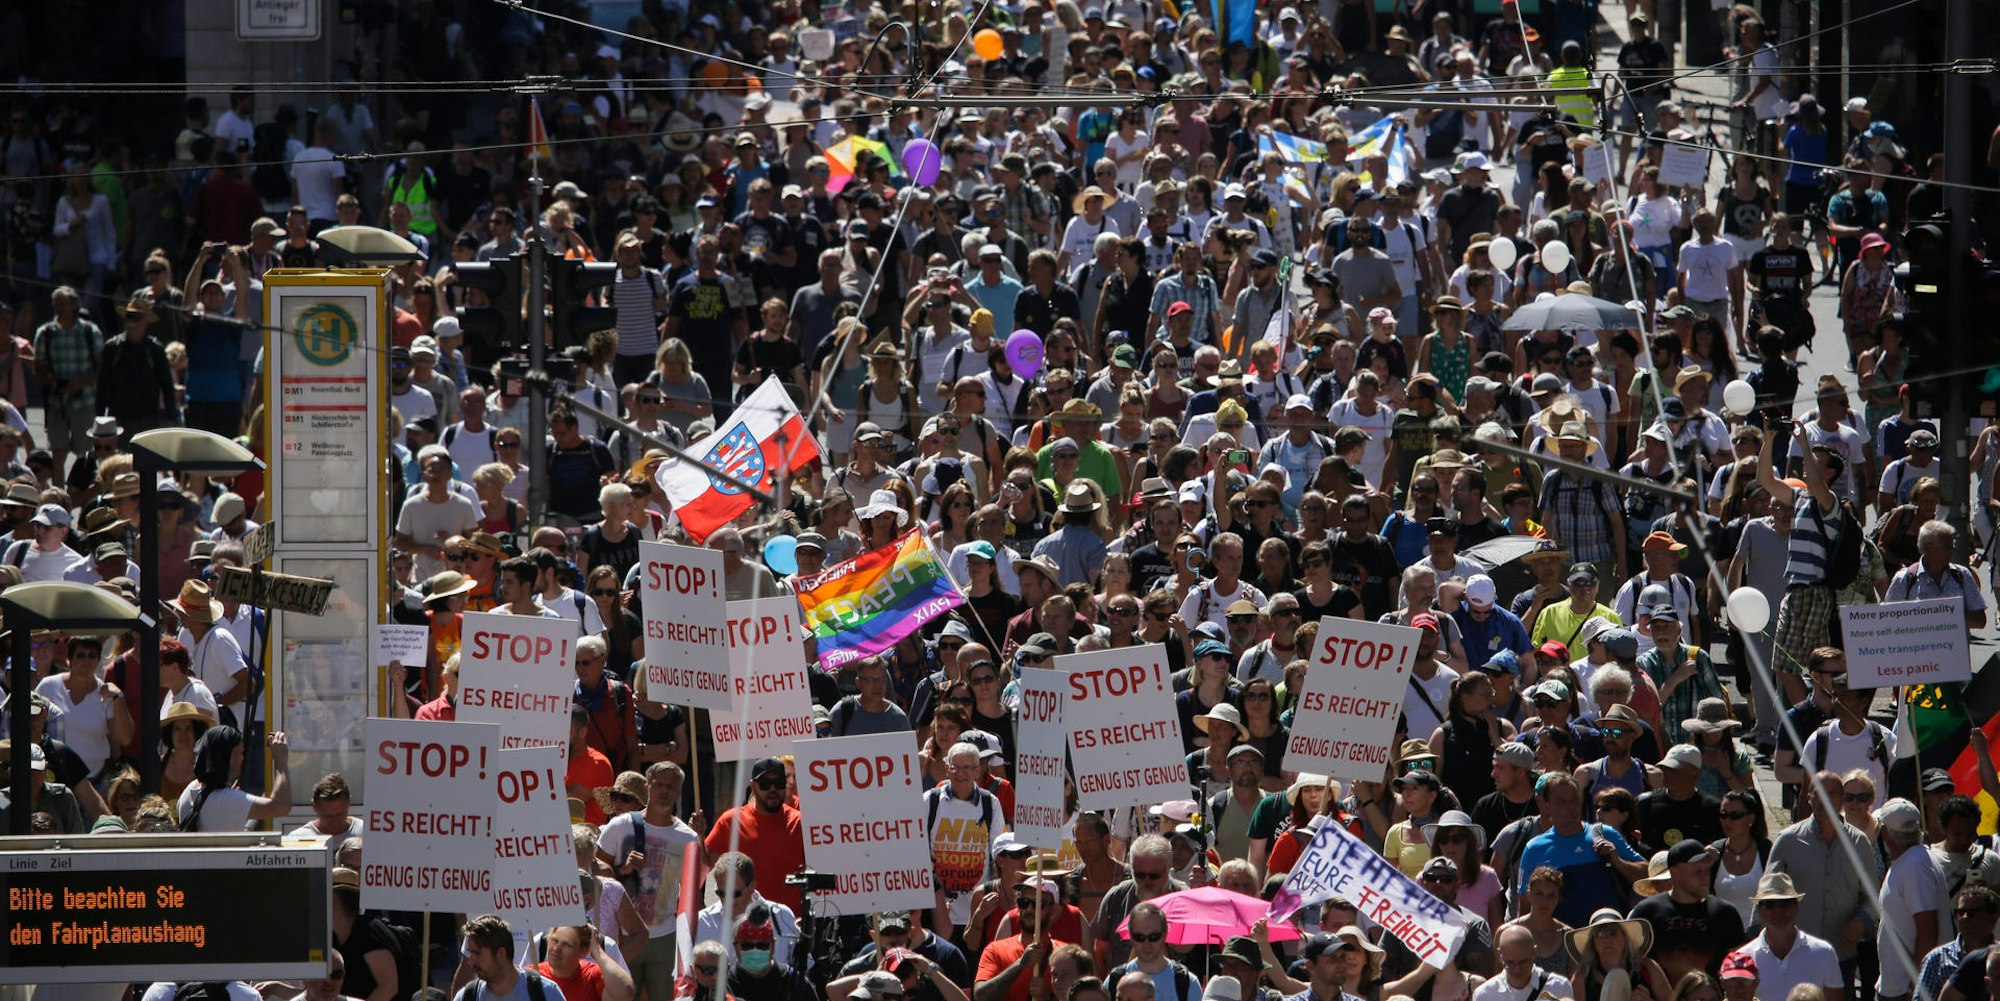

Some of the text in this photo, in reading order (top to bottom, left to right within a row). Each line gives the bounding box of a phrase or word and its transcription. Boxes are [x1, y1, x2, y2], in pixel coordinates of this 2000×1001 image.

[256, 0, 300, 12] Anlieger
[269, 13, 288, 24] frei
[294, 443, 302, 451] 12
[221, 569, 251, 599] ICH
[1850, 605, 1955, 620] More proportionality
[647, 620, 664, 640] ES
[726, 616, 778, 648] TOP
[1850, 622, 1958, 638] More self-determination
[1858, 642, 1954, 656] More transparency
[649, 665, 728, 692] GENUG IST GENUG
[1878, 662, 1940, 676] Less panic
[463, 688, 485, 707] ES
[1303, 692, 1325, 711] ES
[715, 715, 813, 743] GENG IST GENUG
[1074, 729, 1097, 748] ES
[1291, 736, 1387, 765] GENUG IST GENUG
[1020, 754, 1027, 774] ES
[1081, 765, 1185, 793] GENUG IST GENUG
[370, 811, 395, 832] ES
[810, 825, 835, 846] ES
[10, 855, 306, 869] Linie Ziel Abfahrt in
[1302, 850, 1354, 894] EURE
[366, 865, 489, 891] GENUG IST GENUG
[862, 872, 880, 893] IST
[885, 868, 930, 891] GENUG
[1287, 872, 1327, 897] AUF
[9, 886, 184, 910] Bitte beachten Sie
[514, 888, 531, 908] IST
[536, 886, 579, 907] GENUG
[10, 920, 206, 950] den Fahrplanaushang
